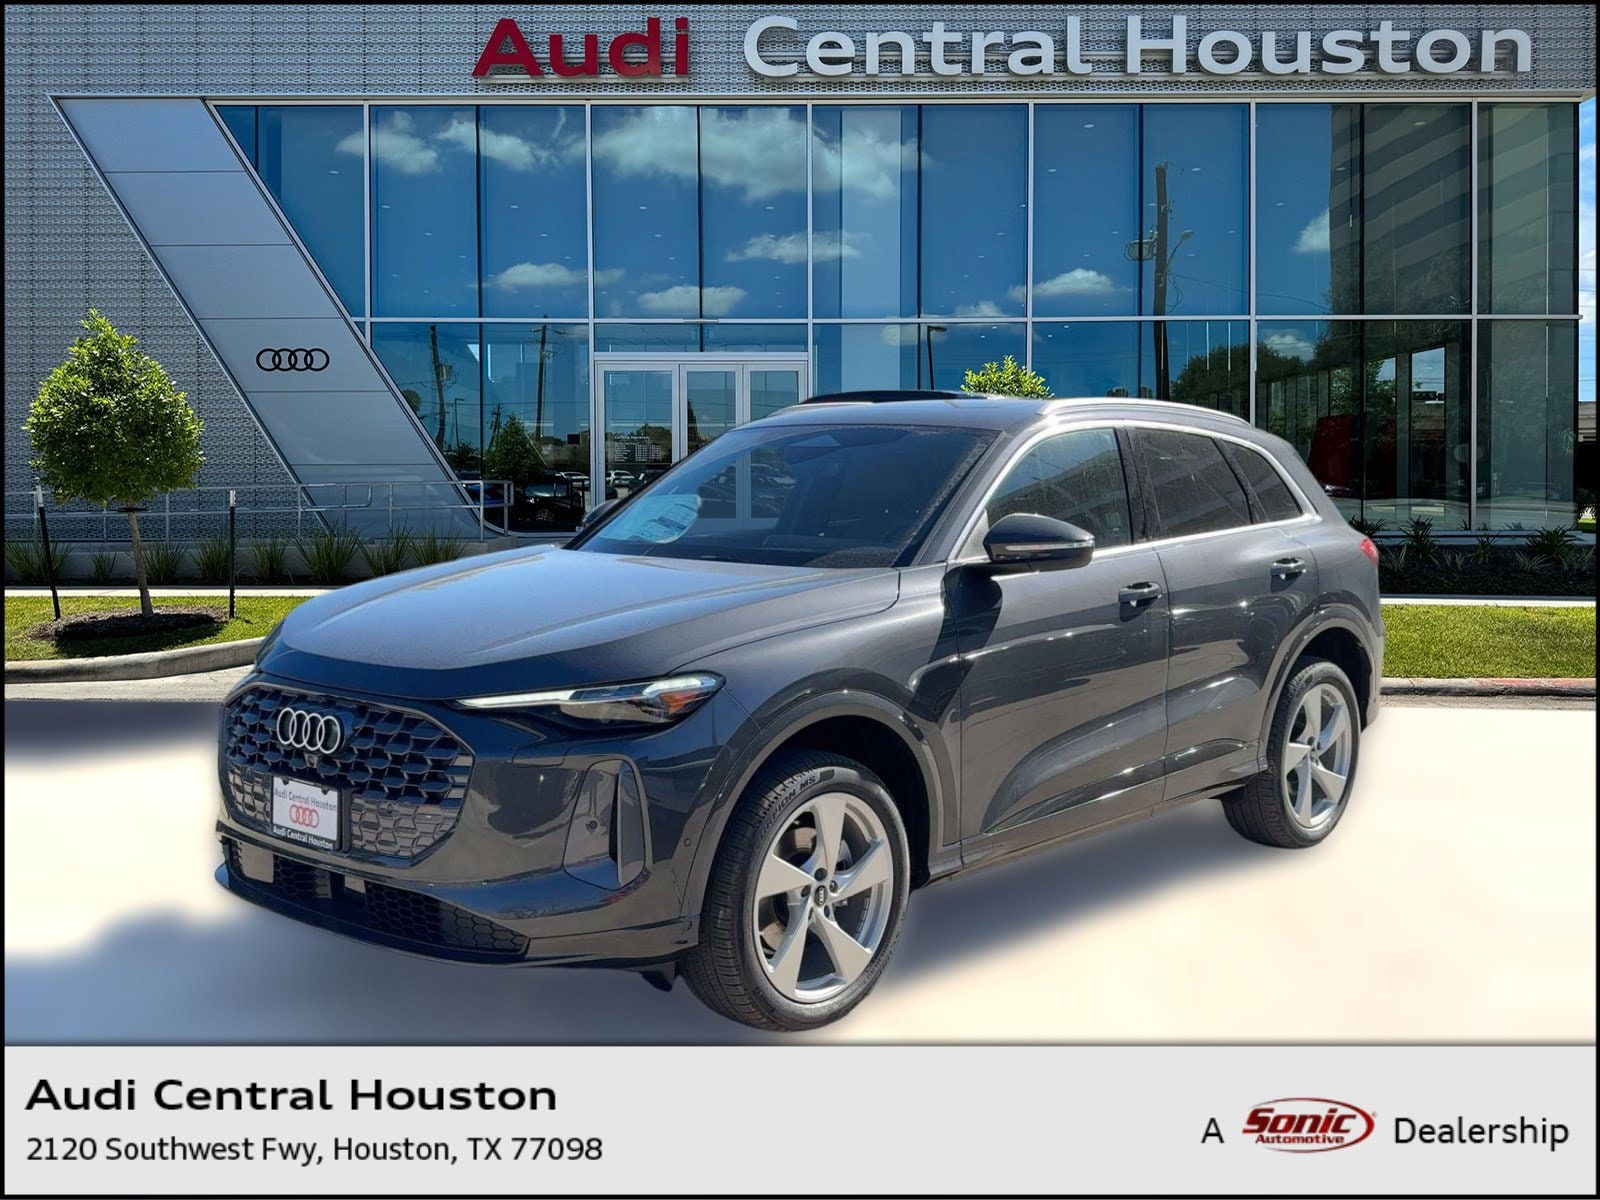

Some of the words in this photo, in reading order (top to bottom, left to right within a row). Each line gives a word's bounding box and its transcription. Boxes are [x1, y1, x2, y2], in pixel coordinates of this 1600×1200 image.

[473, 17, 690, 78] Audi
[744, 15, 1092, 76] Central
[1126, 15, 1532, 75] Houston
[274, 788, 288, 800] Audi
[288, 791, 310, 805] Central
[311, 799, 337, 811] Houston
[273, 825, 287, 837] Audi
[287, 829, 308, 843] Central
[308, 835, 334, 850] Houston
